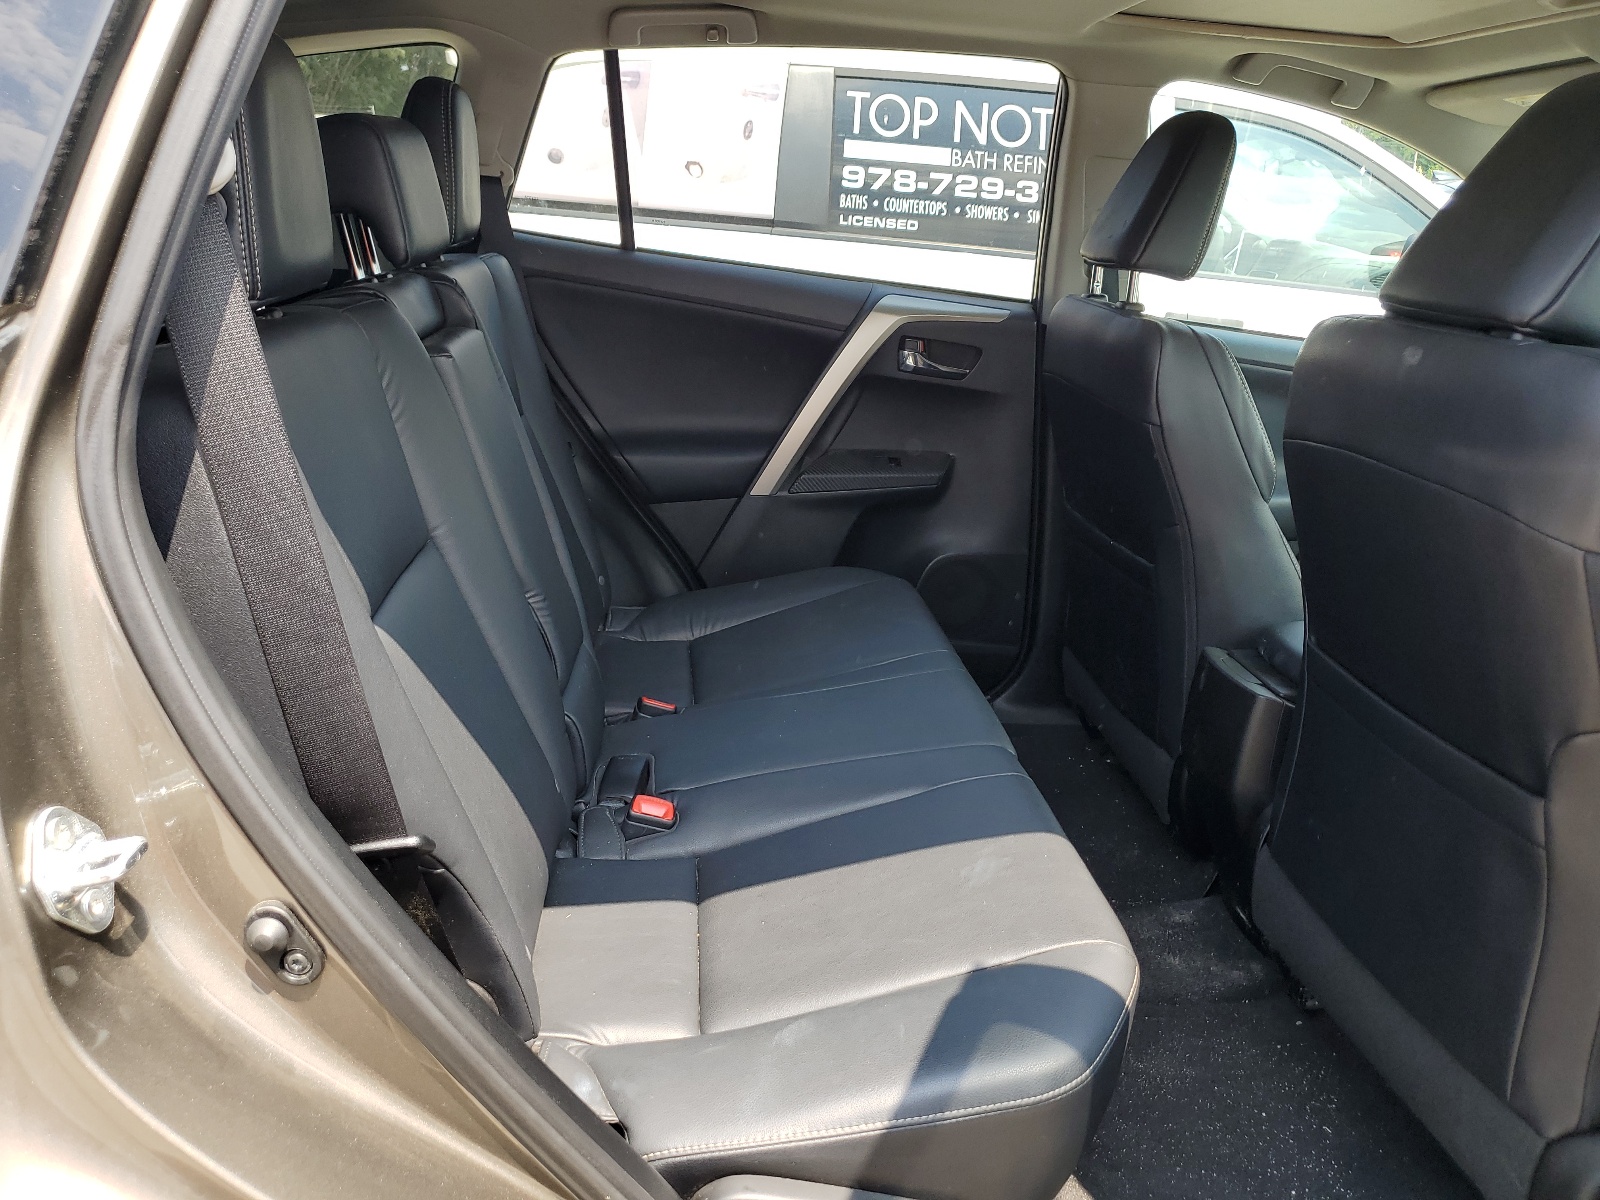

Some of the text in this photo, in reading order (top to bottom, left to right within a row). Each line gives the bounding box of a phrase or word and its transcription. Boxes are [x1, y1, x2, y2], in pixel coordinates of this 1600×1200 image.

[846, 90, 1054, 151] TOP NOT
[951, 148, 997, 171] BATH
[841, 165, 1044, 203] 978-729-3
[839, 193, 868, 210] BATHS
[883, 196, 948, 217] COUNTERTOPS
[965, 205, 1009, 222] SHOWERS
[839, 213, 919, 231] LICENSED
